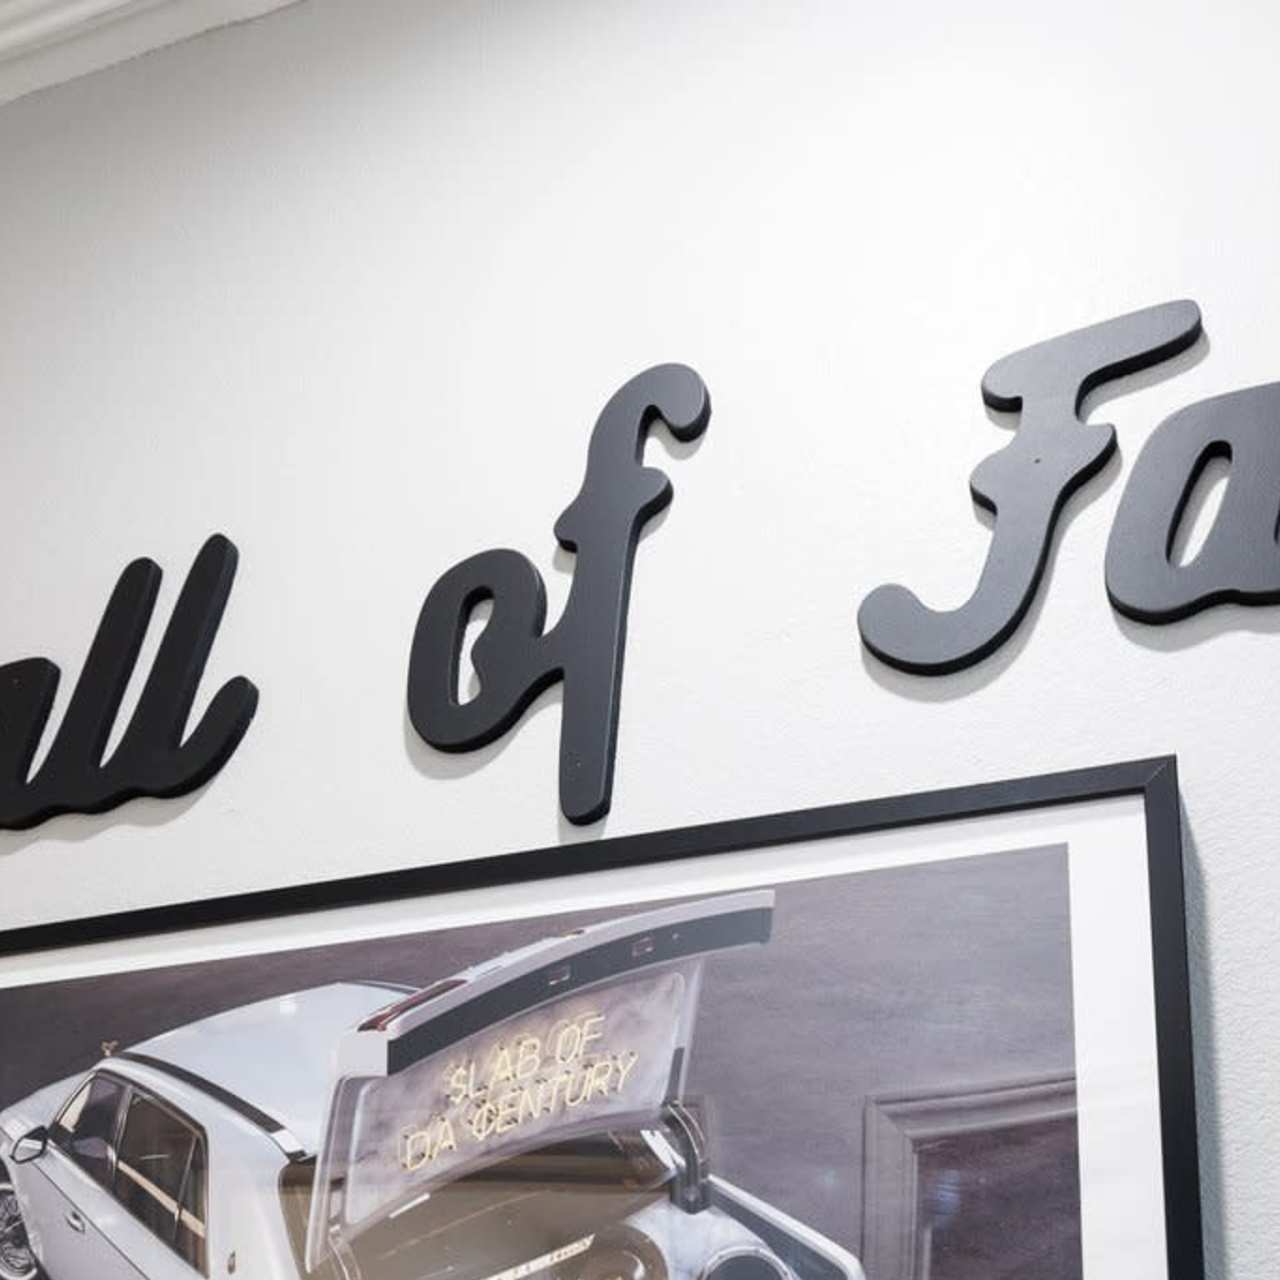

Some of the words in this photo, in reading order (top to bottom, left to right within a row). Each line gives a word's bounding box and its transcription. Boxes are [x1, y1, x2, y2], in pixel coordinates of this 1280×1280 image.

[407, 362, 711, 826] of
[556, 1015, 606, 1064] OF
[406, 1118, 458, 1171] DA
